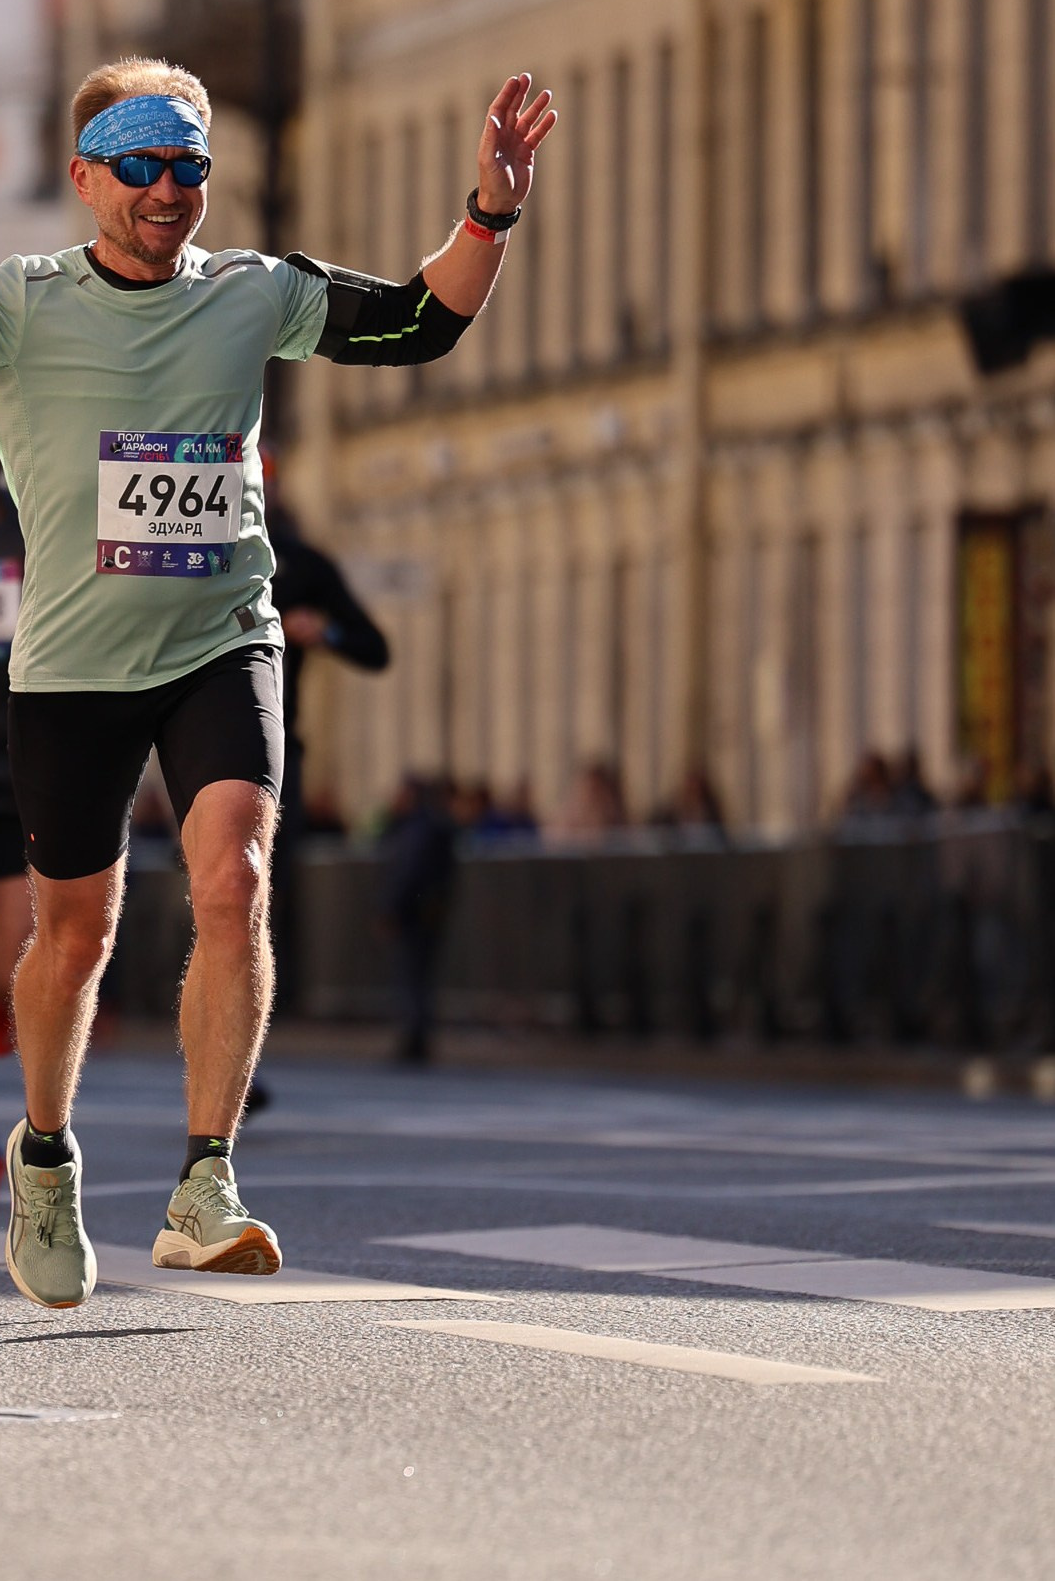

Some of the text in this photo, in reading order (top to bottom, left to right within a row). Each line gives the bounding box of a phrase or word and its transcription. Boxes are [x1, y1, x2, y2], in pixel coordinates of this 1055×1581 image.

[117, 433, 146, 442] ПОЛУ
[182, 442, 203, 455] 21,1
[118, 474, 228, 518] 4964
[148, 522, 203, 537] ЭДУАРД
